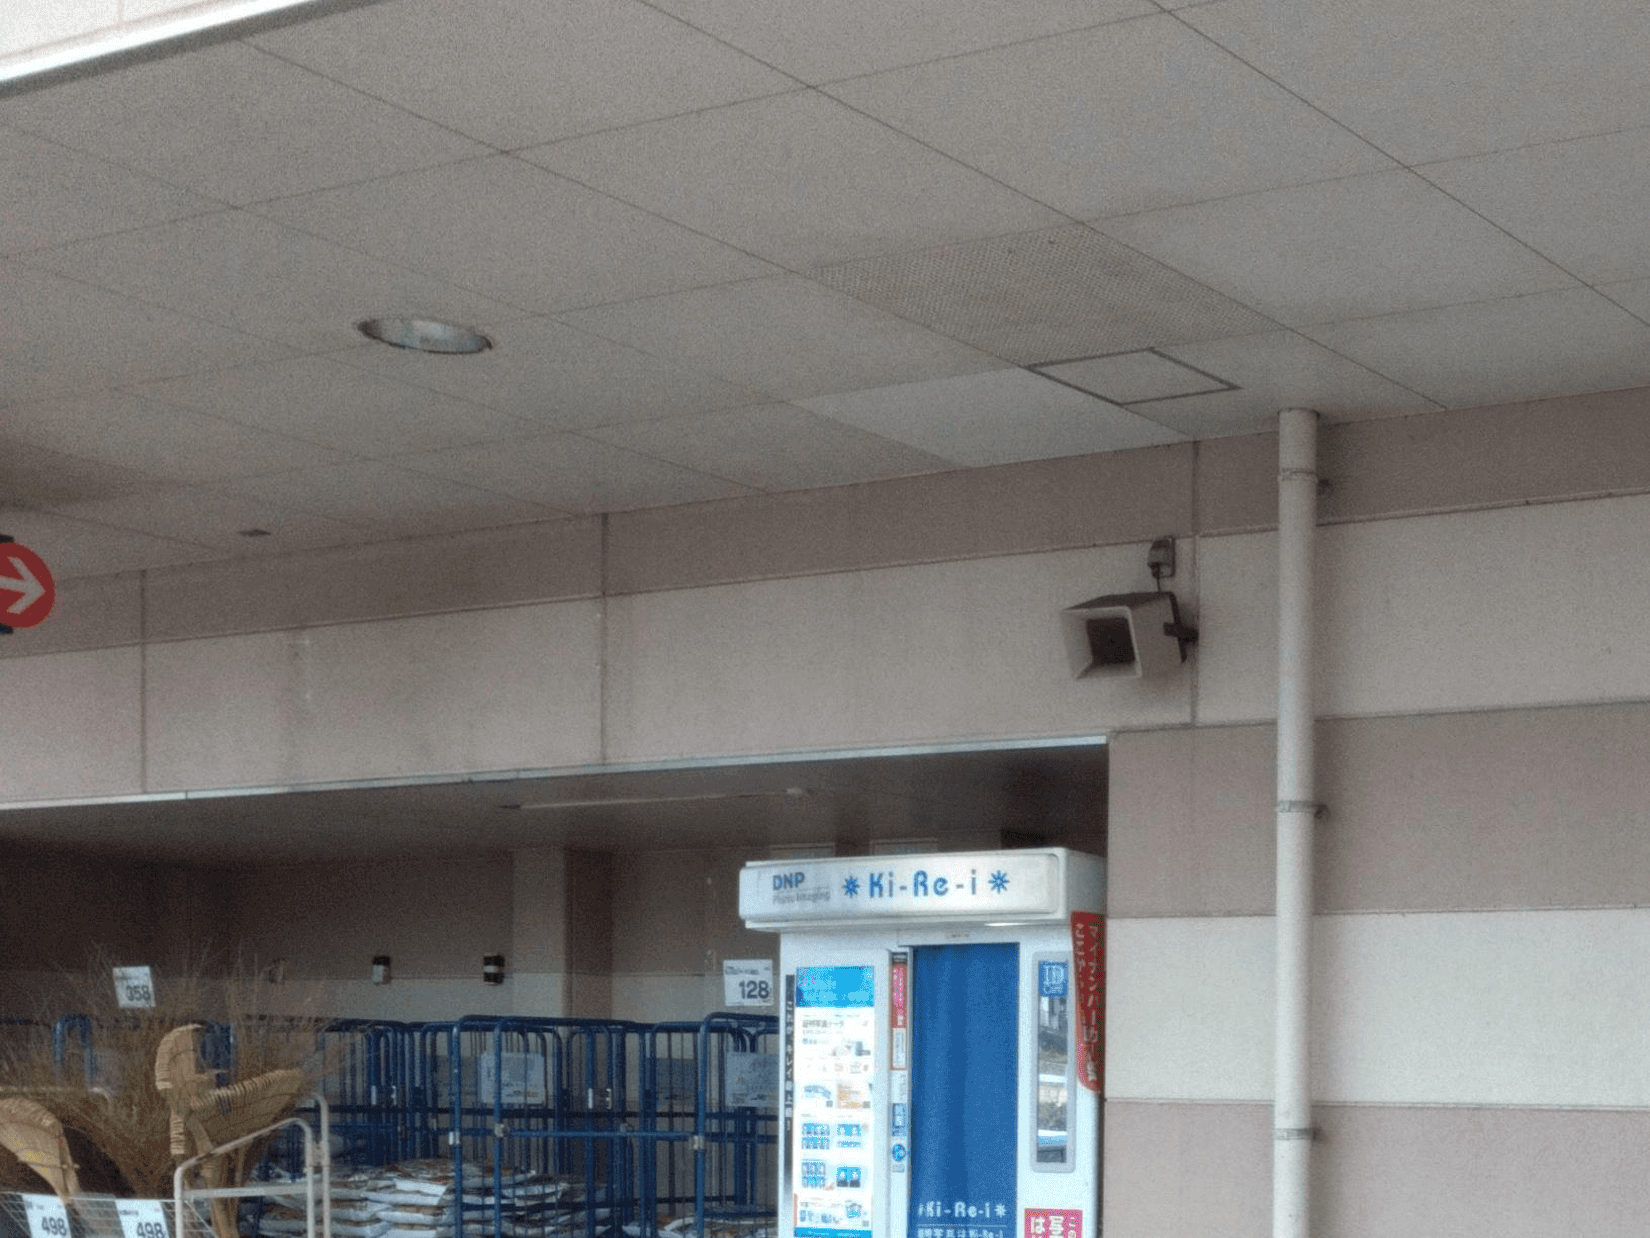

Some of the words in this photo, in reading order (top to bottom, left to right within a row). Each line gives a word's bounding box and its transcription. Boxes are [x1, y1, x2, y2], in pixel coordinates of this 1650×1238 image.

[772, 871, 805, 891] DNP
[868, 868, 978, 898] Ki-Re-i
[738, 979, 770, 999] 128
[41, 1216, 67, 1238] 498
